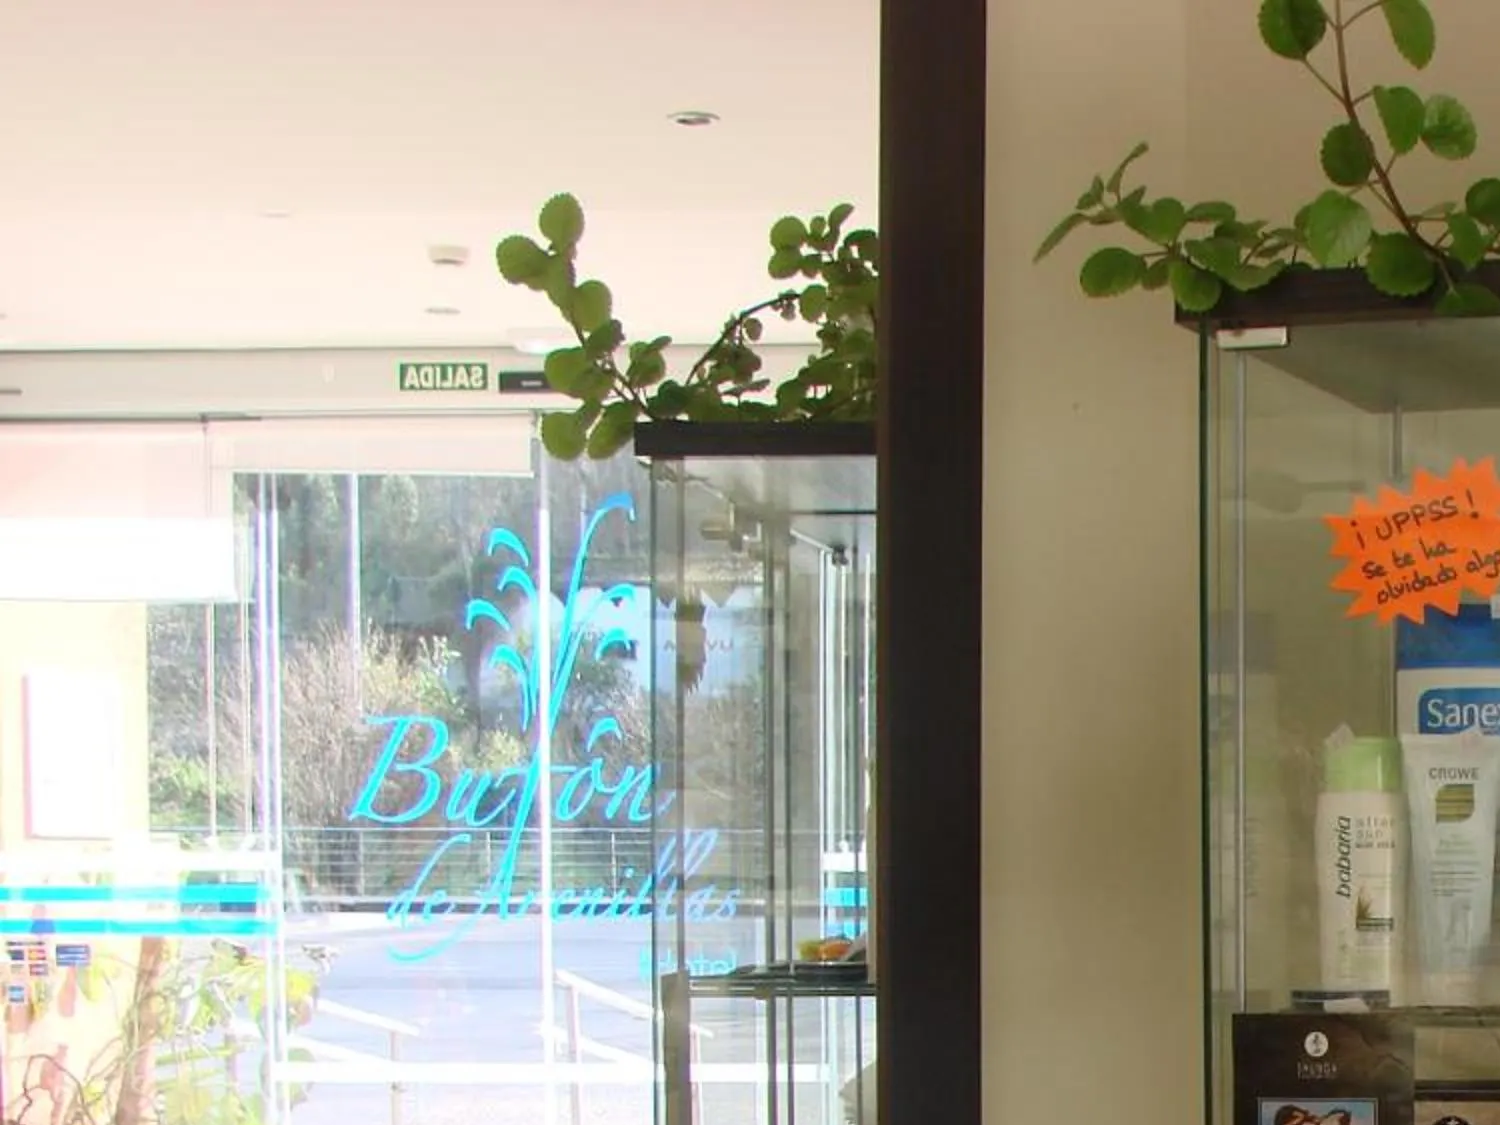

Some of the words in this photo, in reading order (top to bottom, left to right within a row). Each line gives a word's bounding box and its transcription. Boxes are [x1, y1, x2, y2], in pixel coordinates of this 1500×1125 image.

[1391, 550, 1417, 569] te
[1419, 537, 1457, 561] ha
[1376, 564, 1457, 605] olvidado
[385, 832, 457, 929] de
[1334, 815, 1352, 899] babaria
